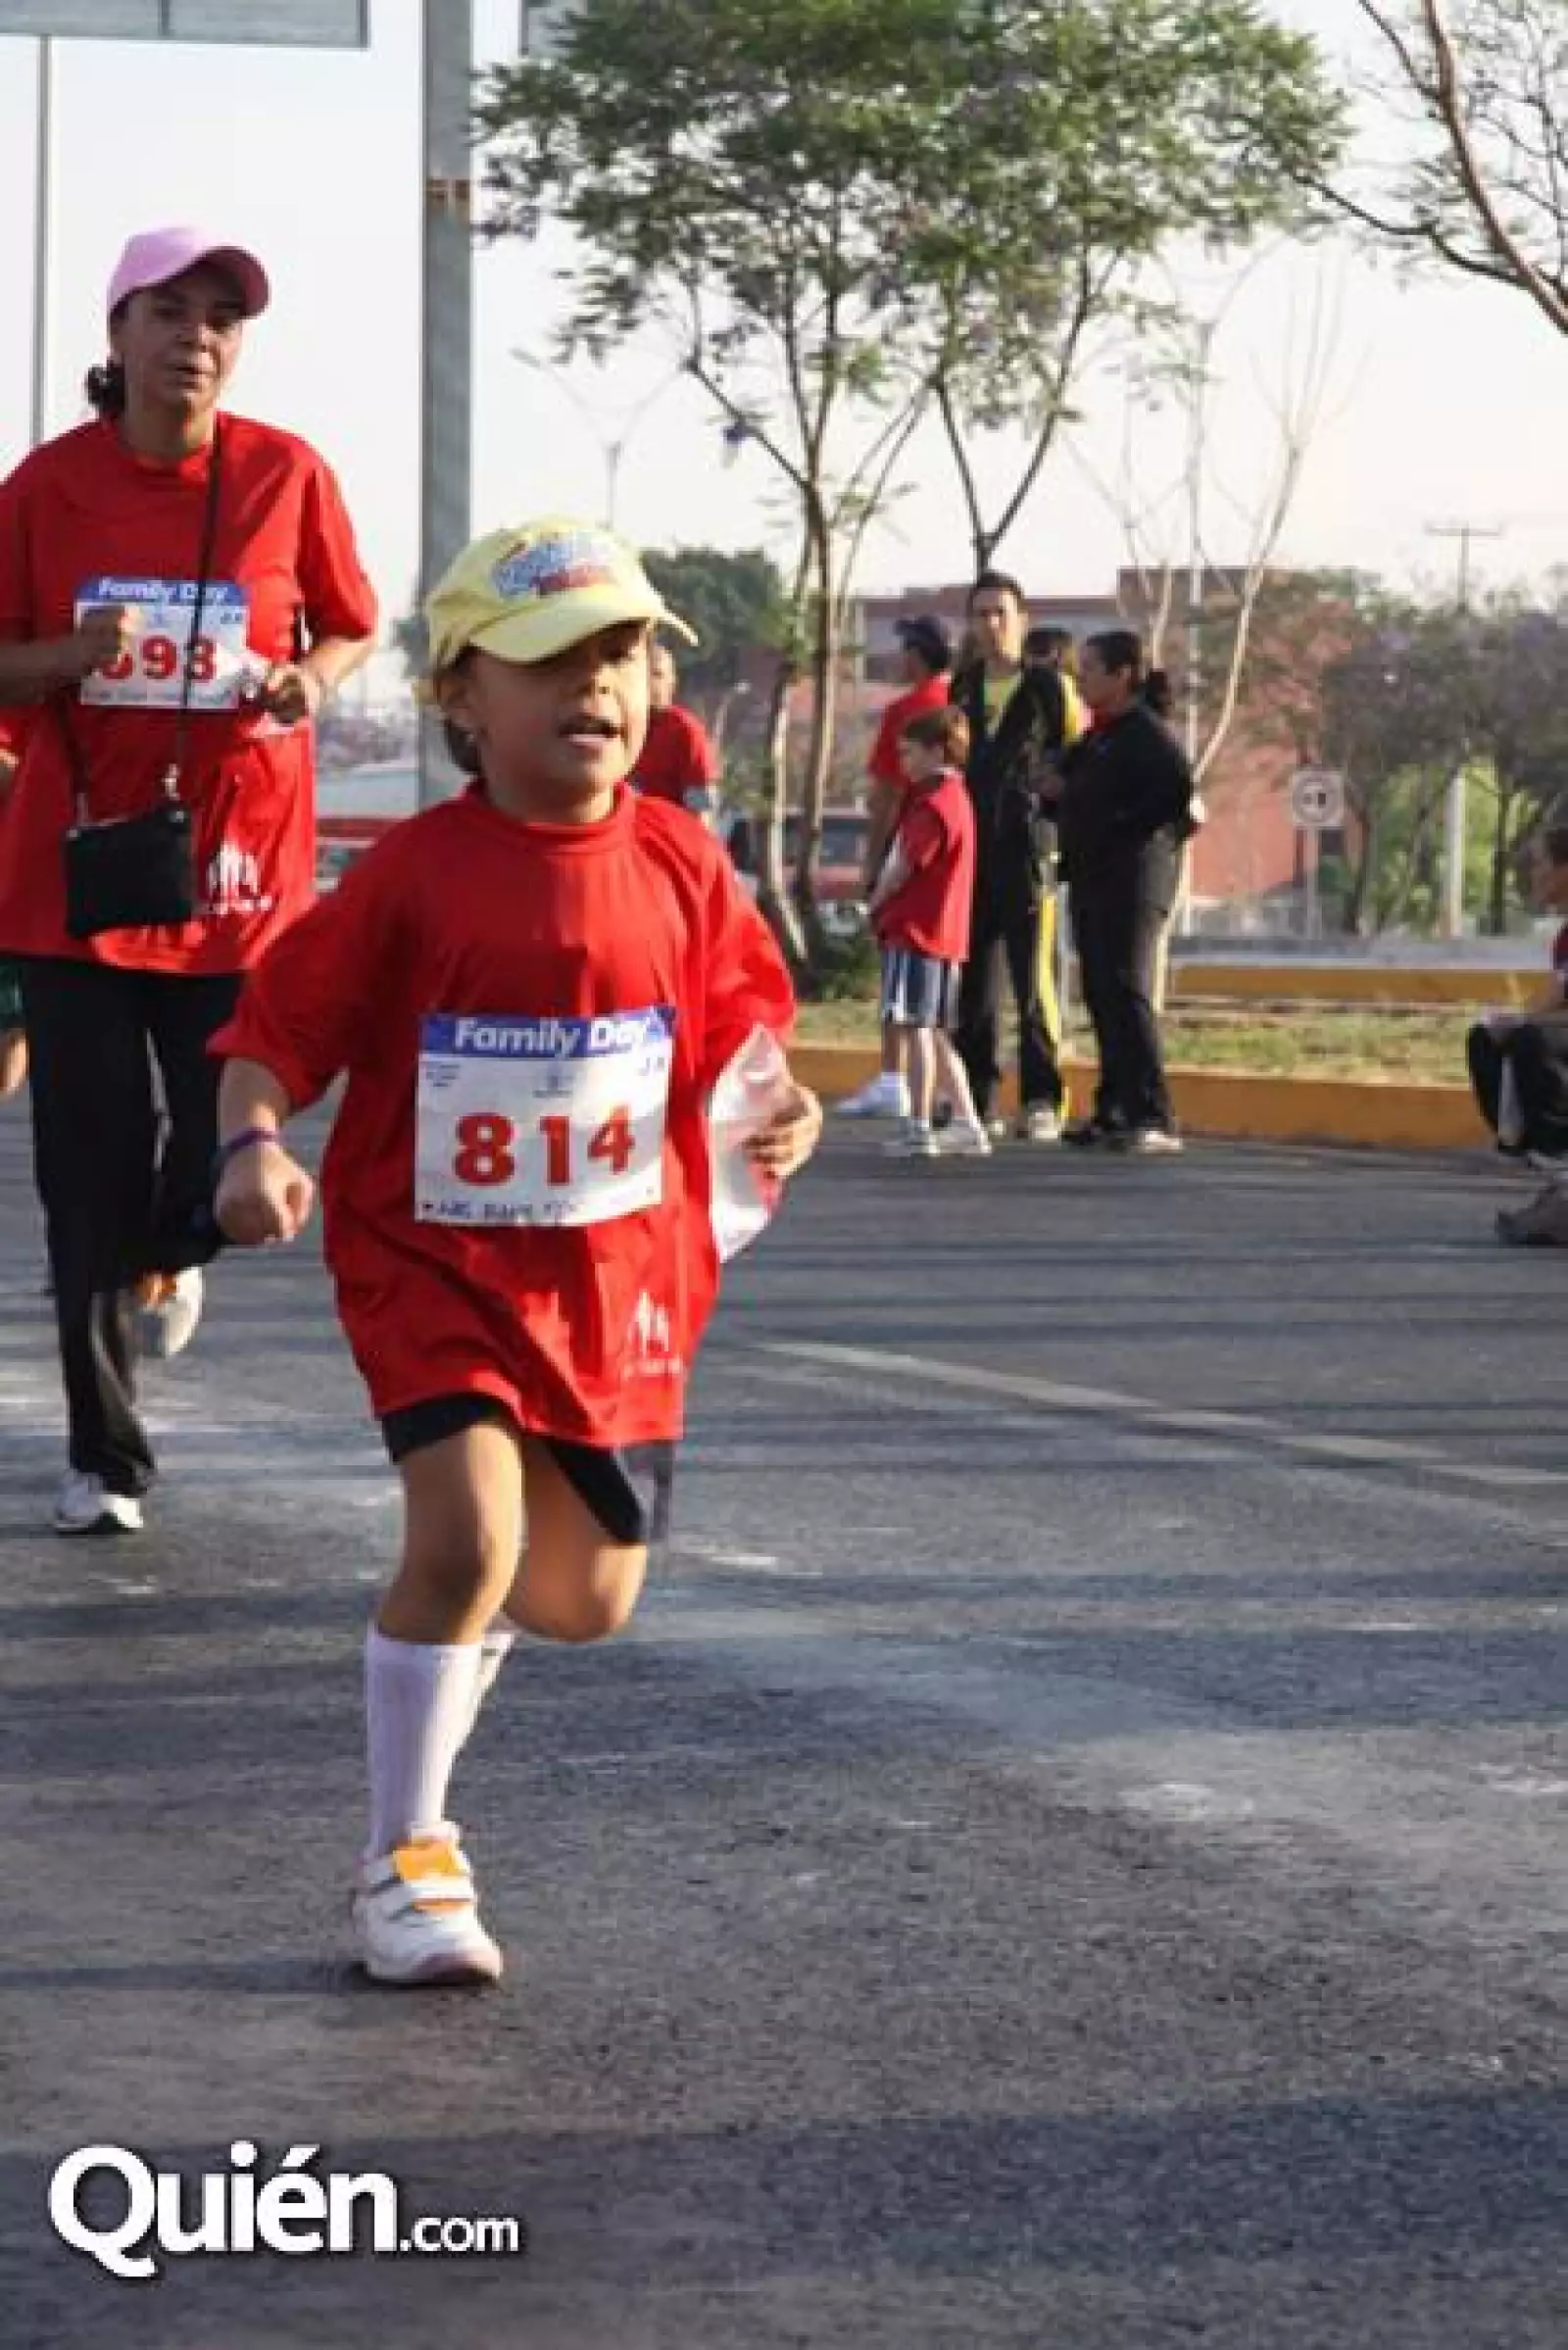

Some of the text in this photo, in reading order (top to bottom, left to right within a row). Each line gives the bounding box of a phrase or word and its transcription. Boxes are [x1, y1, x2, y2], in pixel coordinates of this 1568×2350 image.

[99, 575, 178, 606] Family
[454, 1018, 581, 1057] Family
[454, 1104, 637, 1187] 814
